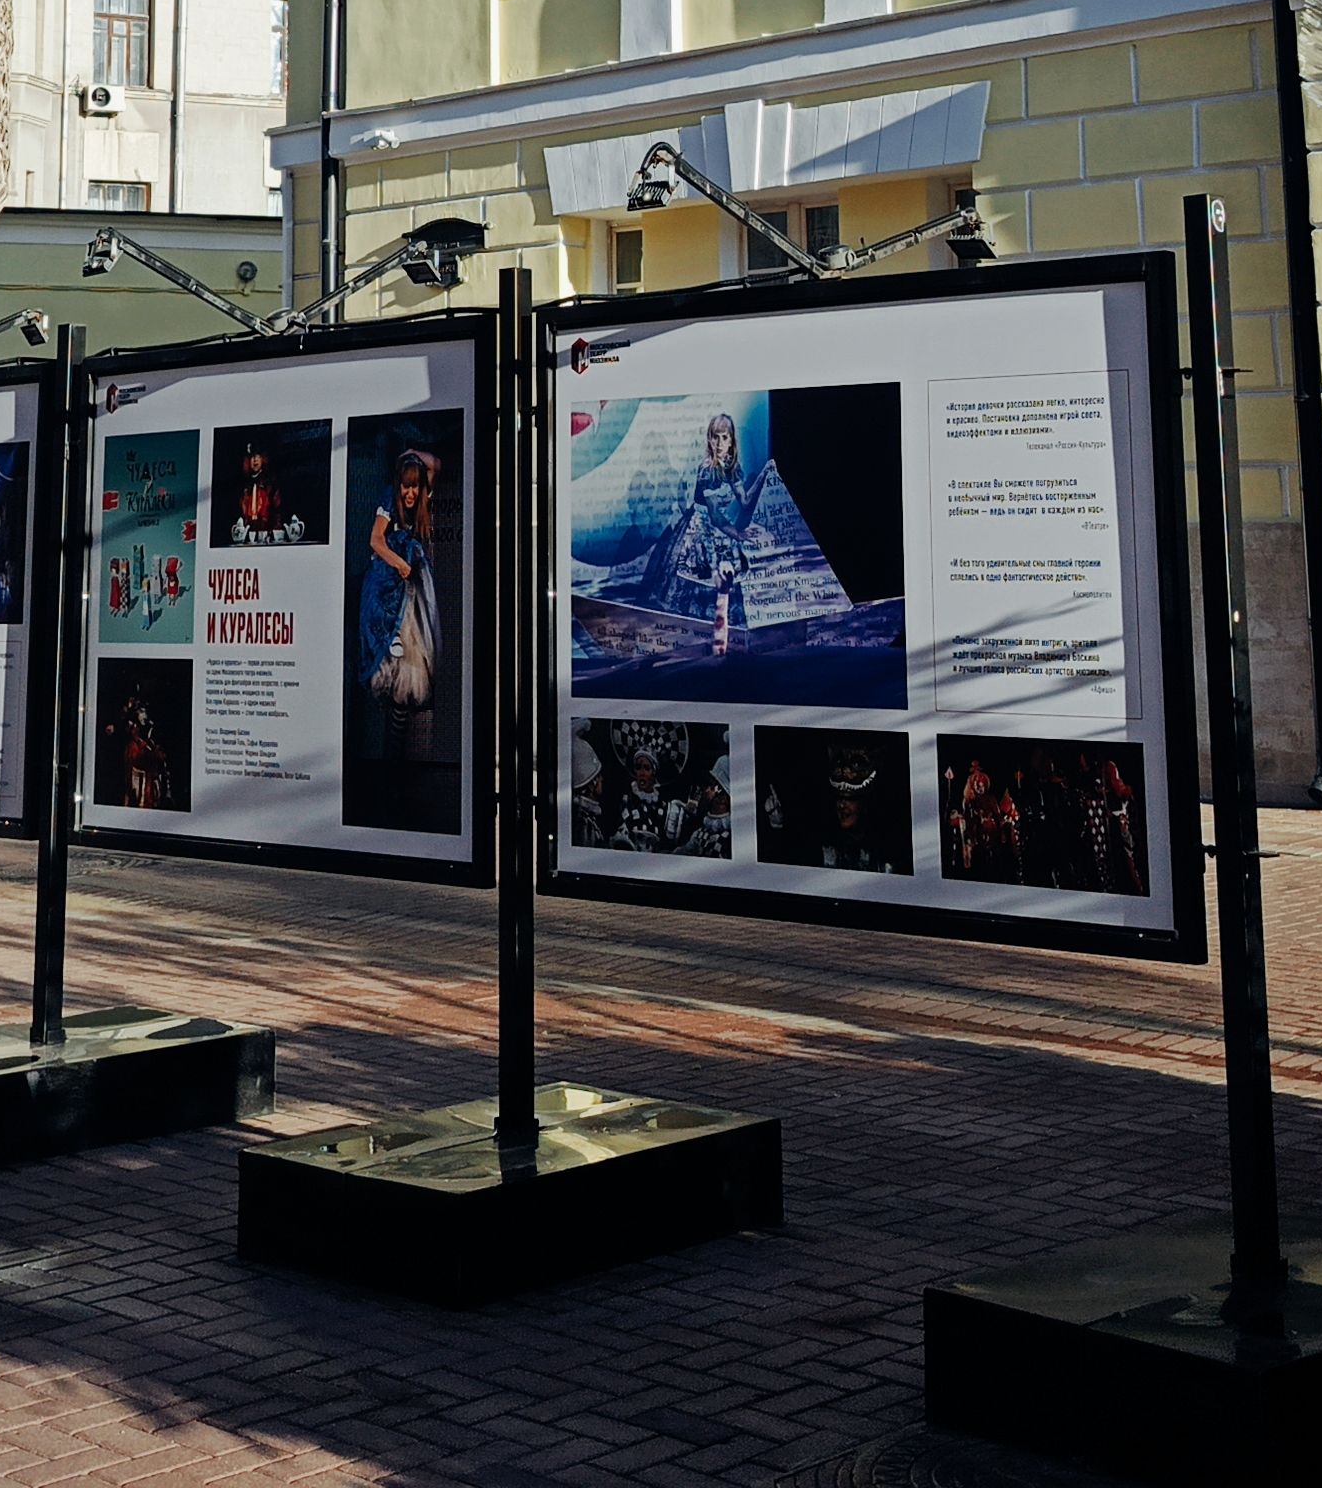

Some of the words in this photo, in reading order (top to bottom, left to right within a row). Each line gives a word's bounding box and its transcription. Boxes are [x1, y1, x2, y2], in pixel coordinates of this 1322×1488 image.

[1006, 400, 1044, 410] рассказана
[1069, 397, 1105, 407] интересно
[982, 414, 1020, 423] Постановка
[1021, 412, 1058, 423] дополнена
[1059, 410, 1079, 421] игрой
[946, 427, 1003, 439] видеоэффектами
[958, 481, 992, 489] спектакле
[1005, 480, 1034, 488] сможете
[1035, 478, 1078, 489] погрузиться
[954, 493, 990, 502] необычный
[1045, 492, 1097, 502] восторженным
[989, 507, 1006, 516] ведь
[1017, 507, 1038, 516] сидит
[1047, 506, 1076, 515] каждом
[959, 558, 970, 567] без
[971, 560, 985, 568] того
[986, 559, 1031, 569] удивительные
[1047, 558, 1073, 567] главной
[985, 573, 1002, 582] одно
[1002, 572, 1054, 583] фантастическое
[208, 568, 260, 604] ЧУДЕСА
[794, 590, 810, 602] the
[812, 588, 839, 601] White
[766, 608, 802, 620] nervous
[207, 612, 216, 644] И
[220, 611, 294, 645] КУРАЛЕСЫ
[1007, 652, 1033, 662] музыка
[1033, 650, 1071, 662] Владимира
[1005, 665, 1043, 675] российских
[1045, 667, 1074, 677] артистов
